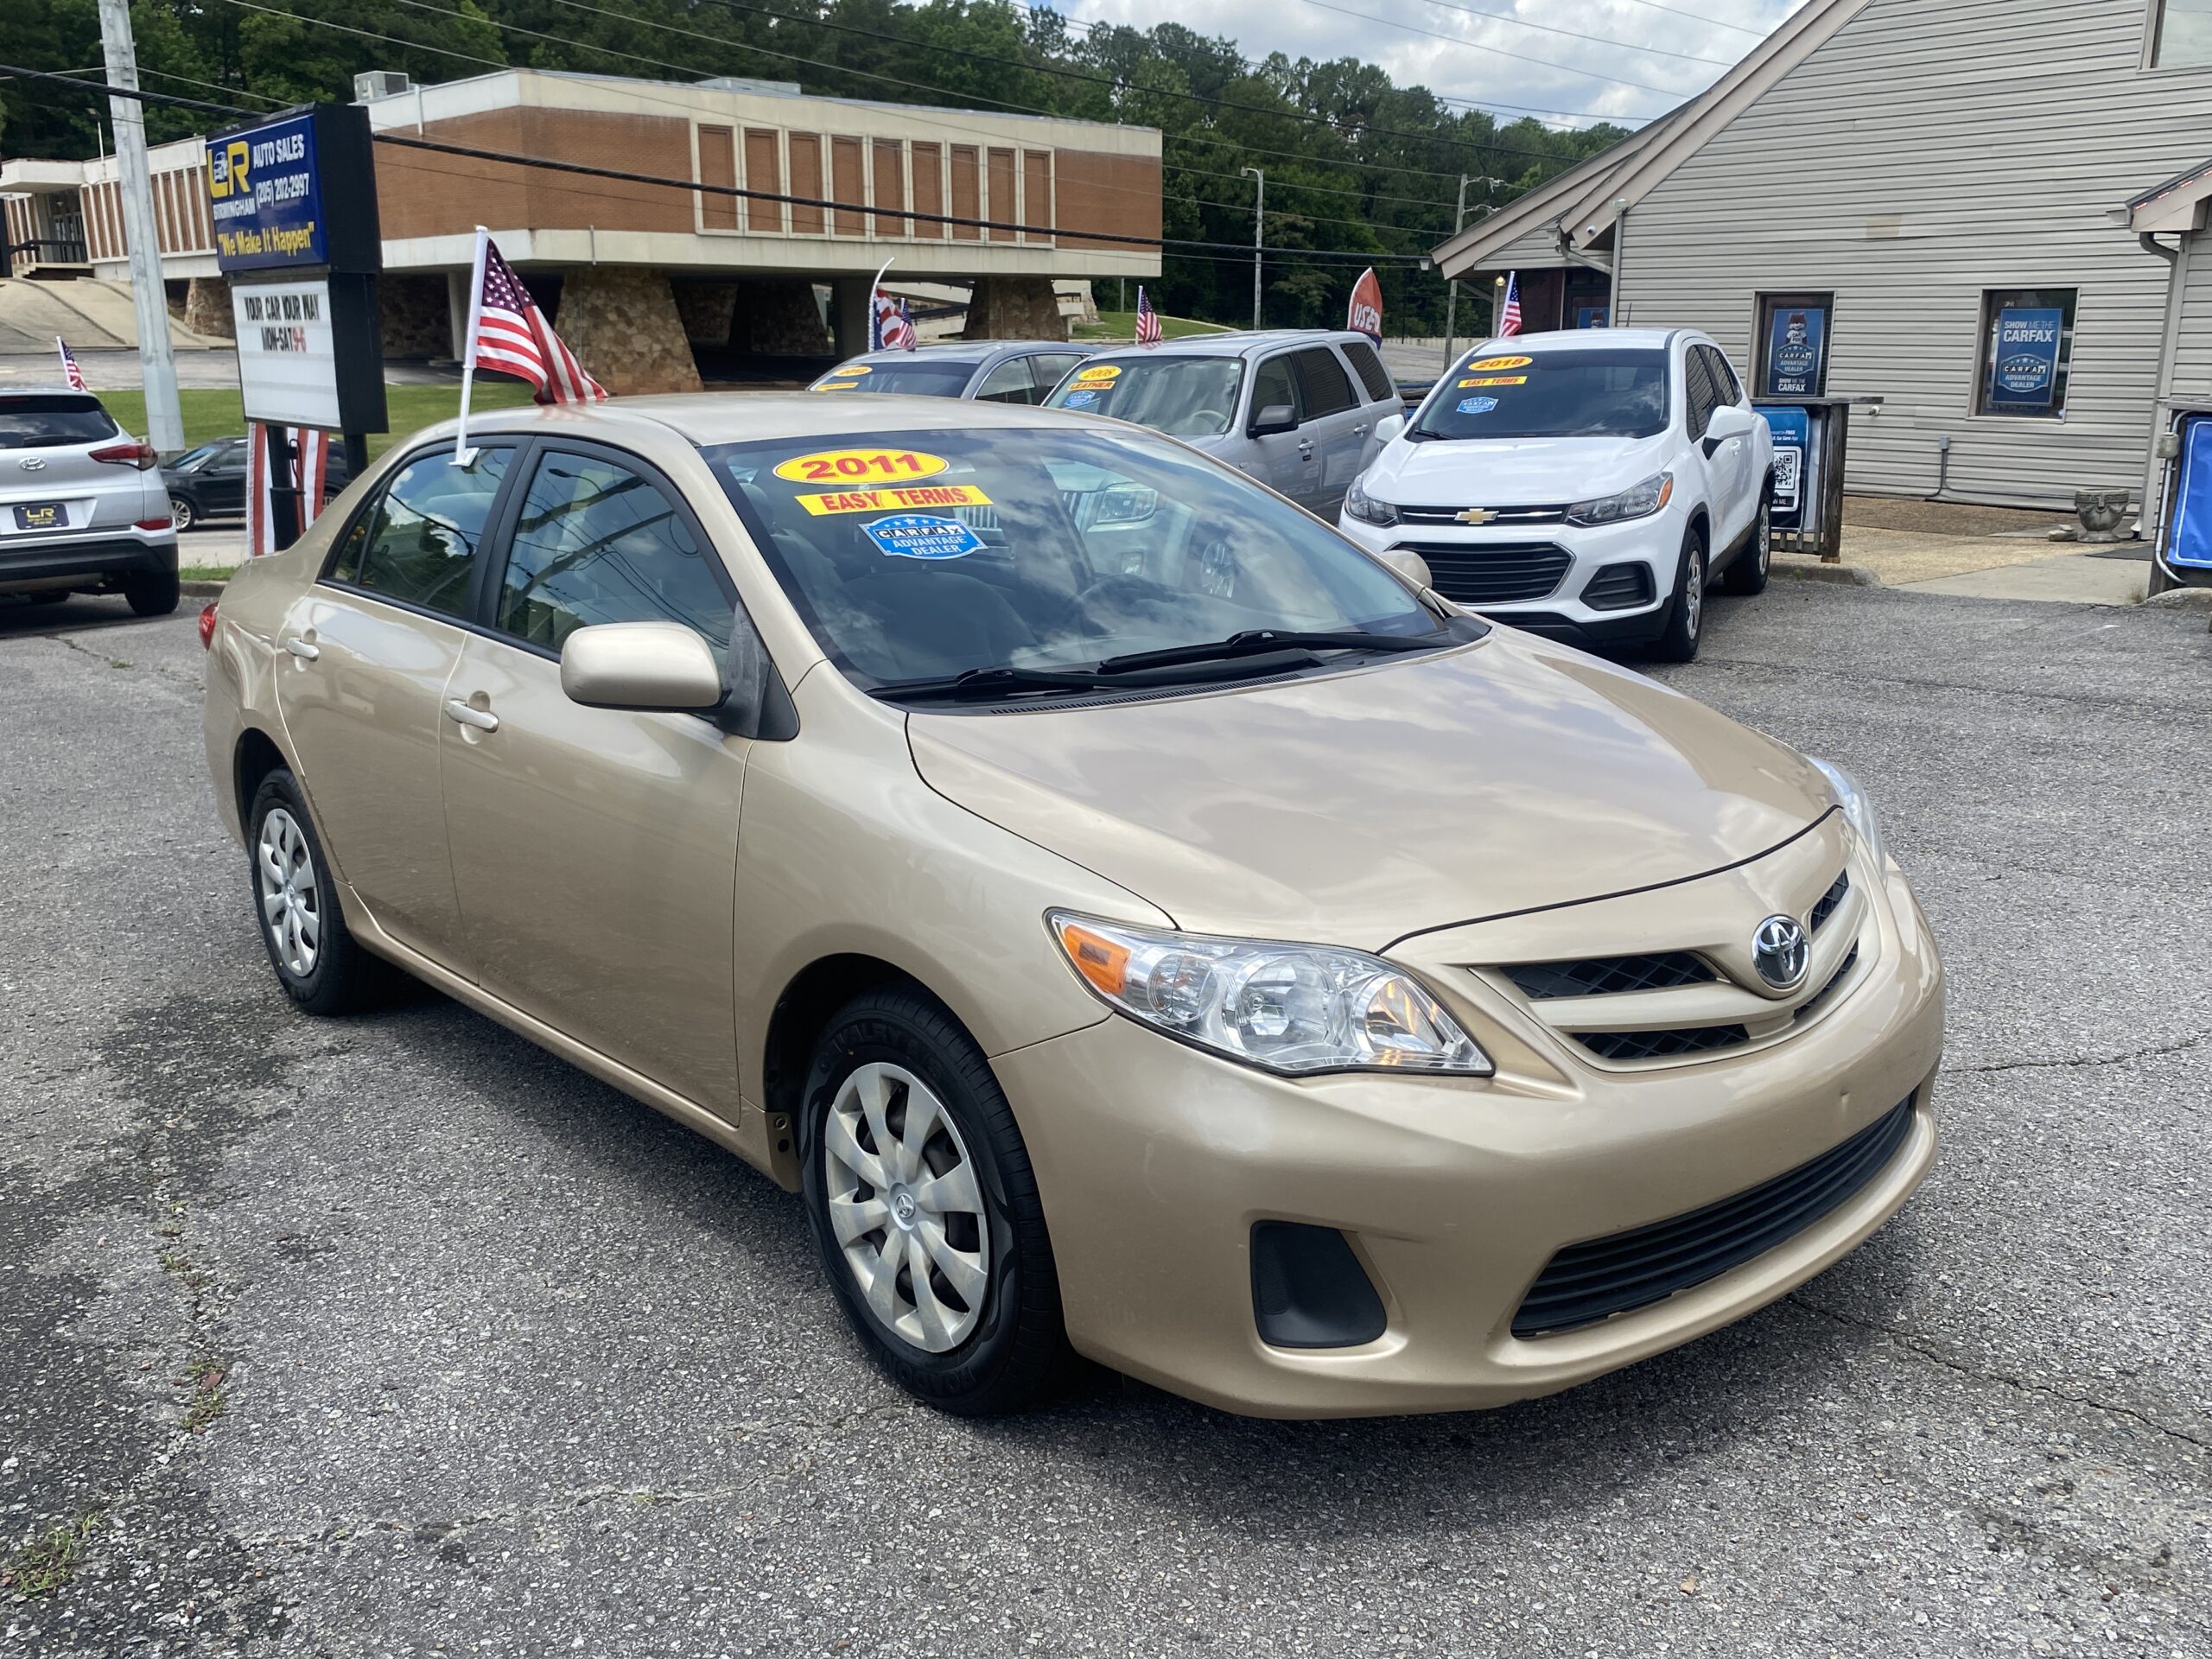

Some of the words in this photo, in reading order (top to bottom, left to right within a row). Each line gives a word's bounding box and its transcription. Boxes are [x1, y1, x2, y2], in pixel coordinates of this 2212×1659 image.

[253, 142, 275, 168] AUTO
[276, 133, 304, 163] SALES
[256, 180, 275, 209] (205)
[275, 173, 309, 200] 202-2997
[213, 197, 256, 220] BIRMINGHAM
[236, 229, 262, 255] Make
[263, 227, 272, 252] It
[271, 221, 315, 257] Happen"
[244, 296, 264, 321] YOUR
[265, 296, 282, 321] CAR
[281, 295, 302, 321] YOUR
[302, 294, 320, 321] WAY
[1354, 302, 1380, 333] USED
[2003, 329, 2053, 342] CARFAX
[2004, 321, 2027, 329] SHOW
[2029, 321, 2040, 329] ME
[2041, 321, 2055, 329] THE
[1475, 358, 1526, 369] 2018
[801, 454, 924, 480] 2011
[820, 491, 883, 511] EASY
[892, 486, 973, 506] TERMS
[27, 507, 54, 518] LR
[875, 525, 964, 538] CARFAX
[893, 535, 967, 548] ADVANTAGE
[910, 544, 962, 555] DEALER
